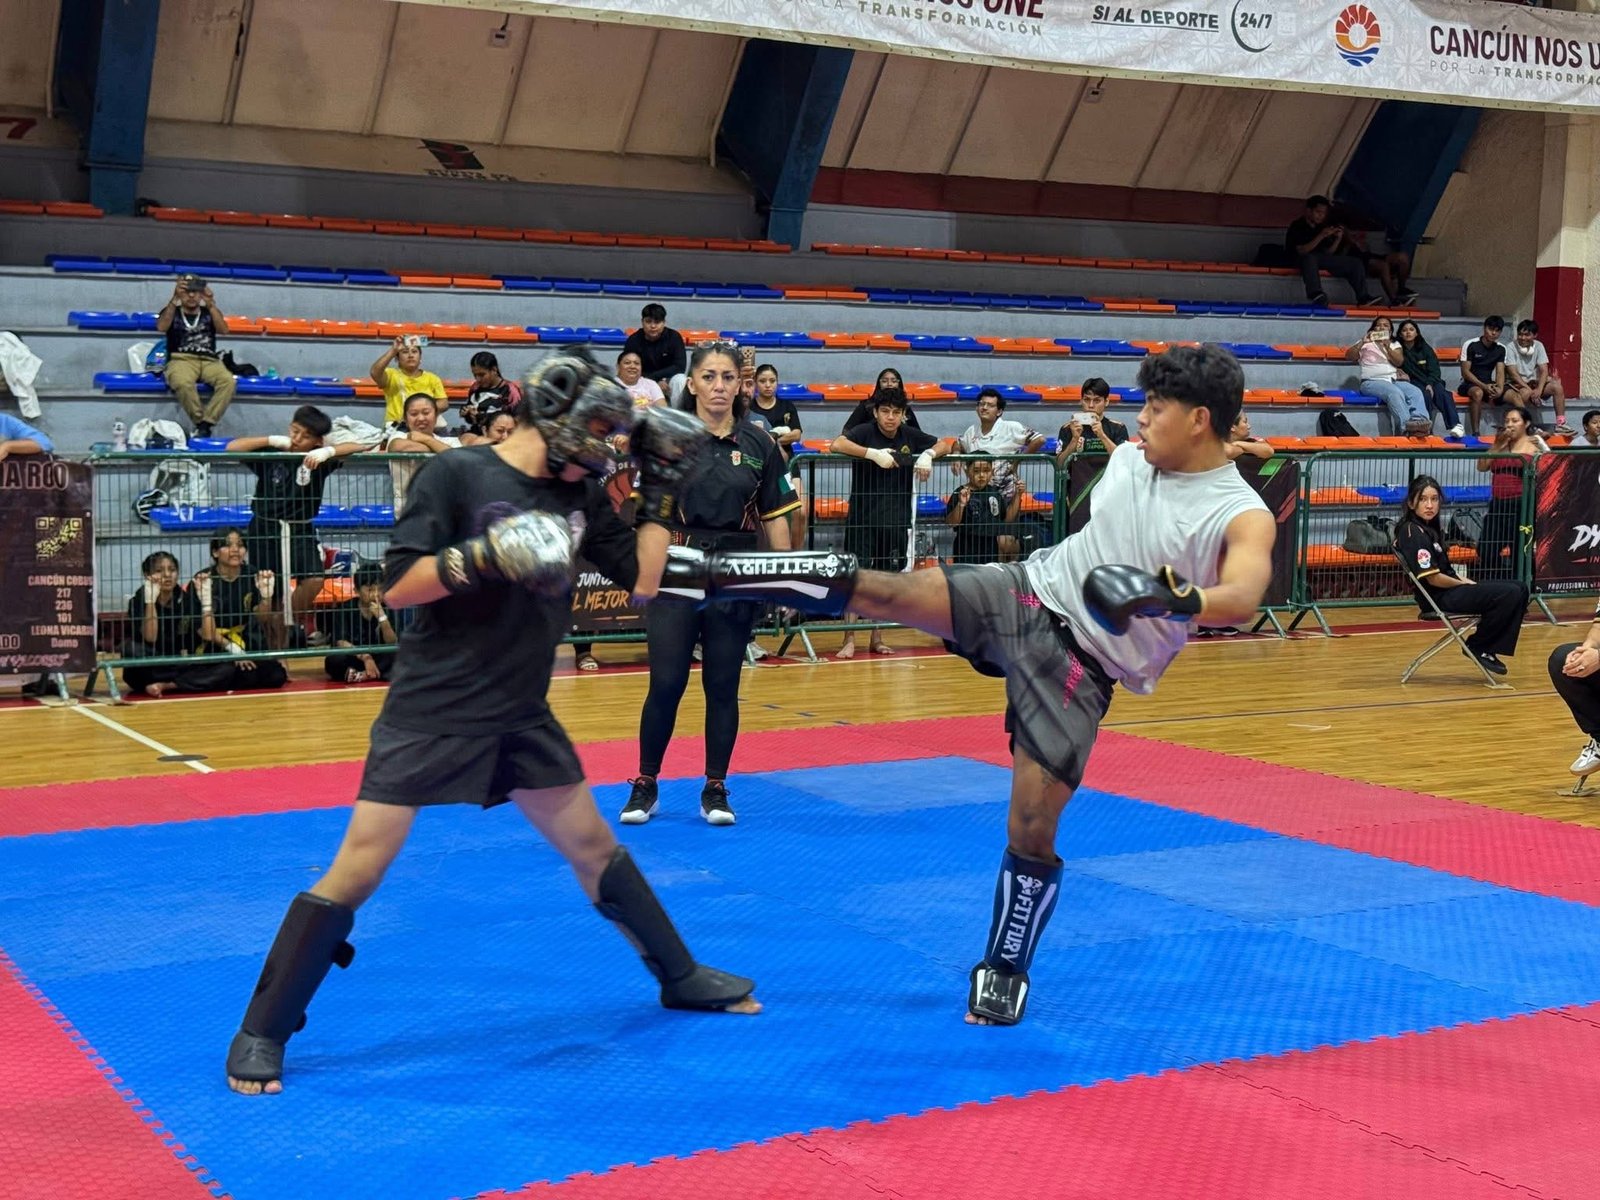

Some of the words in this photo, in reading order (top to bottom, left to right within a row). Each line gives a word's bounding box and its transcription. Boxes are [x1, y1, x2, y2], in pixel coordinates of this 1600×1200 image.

[858, 1, 1041, 36] TRANSFORMACIÓN
[1093, 5, 1110, 21] SI
[1113, 7, 1135, 23] AL
[1140, 10, 1219, 29] DEPORTE
[1239, 12, 1272, 29] 24/7
[1430, 25, 1528, 64] CANCÚN
[1535, 36, 1583, 68] NOS
[1430, 60, 1459, 73] POR
[1468, 63, 1486, 75] LA
[0, 461, 22, 489] A
[57, 588, 71, 598] 217
[584, 590, 630, 612] MEJOR
[1012, 894, 1033, 925] FIT
[1001, 922, 1026, 965] FURY
